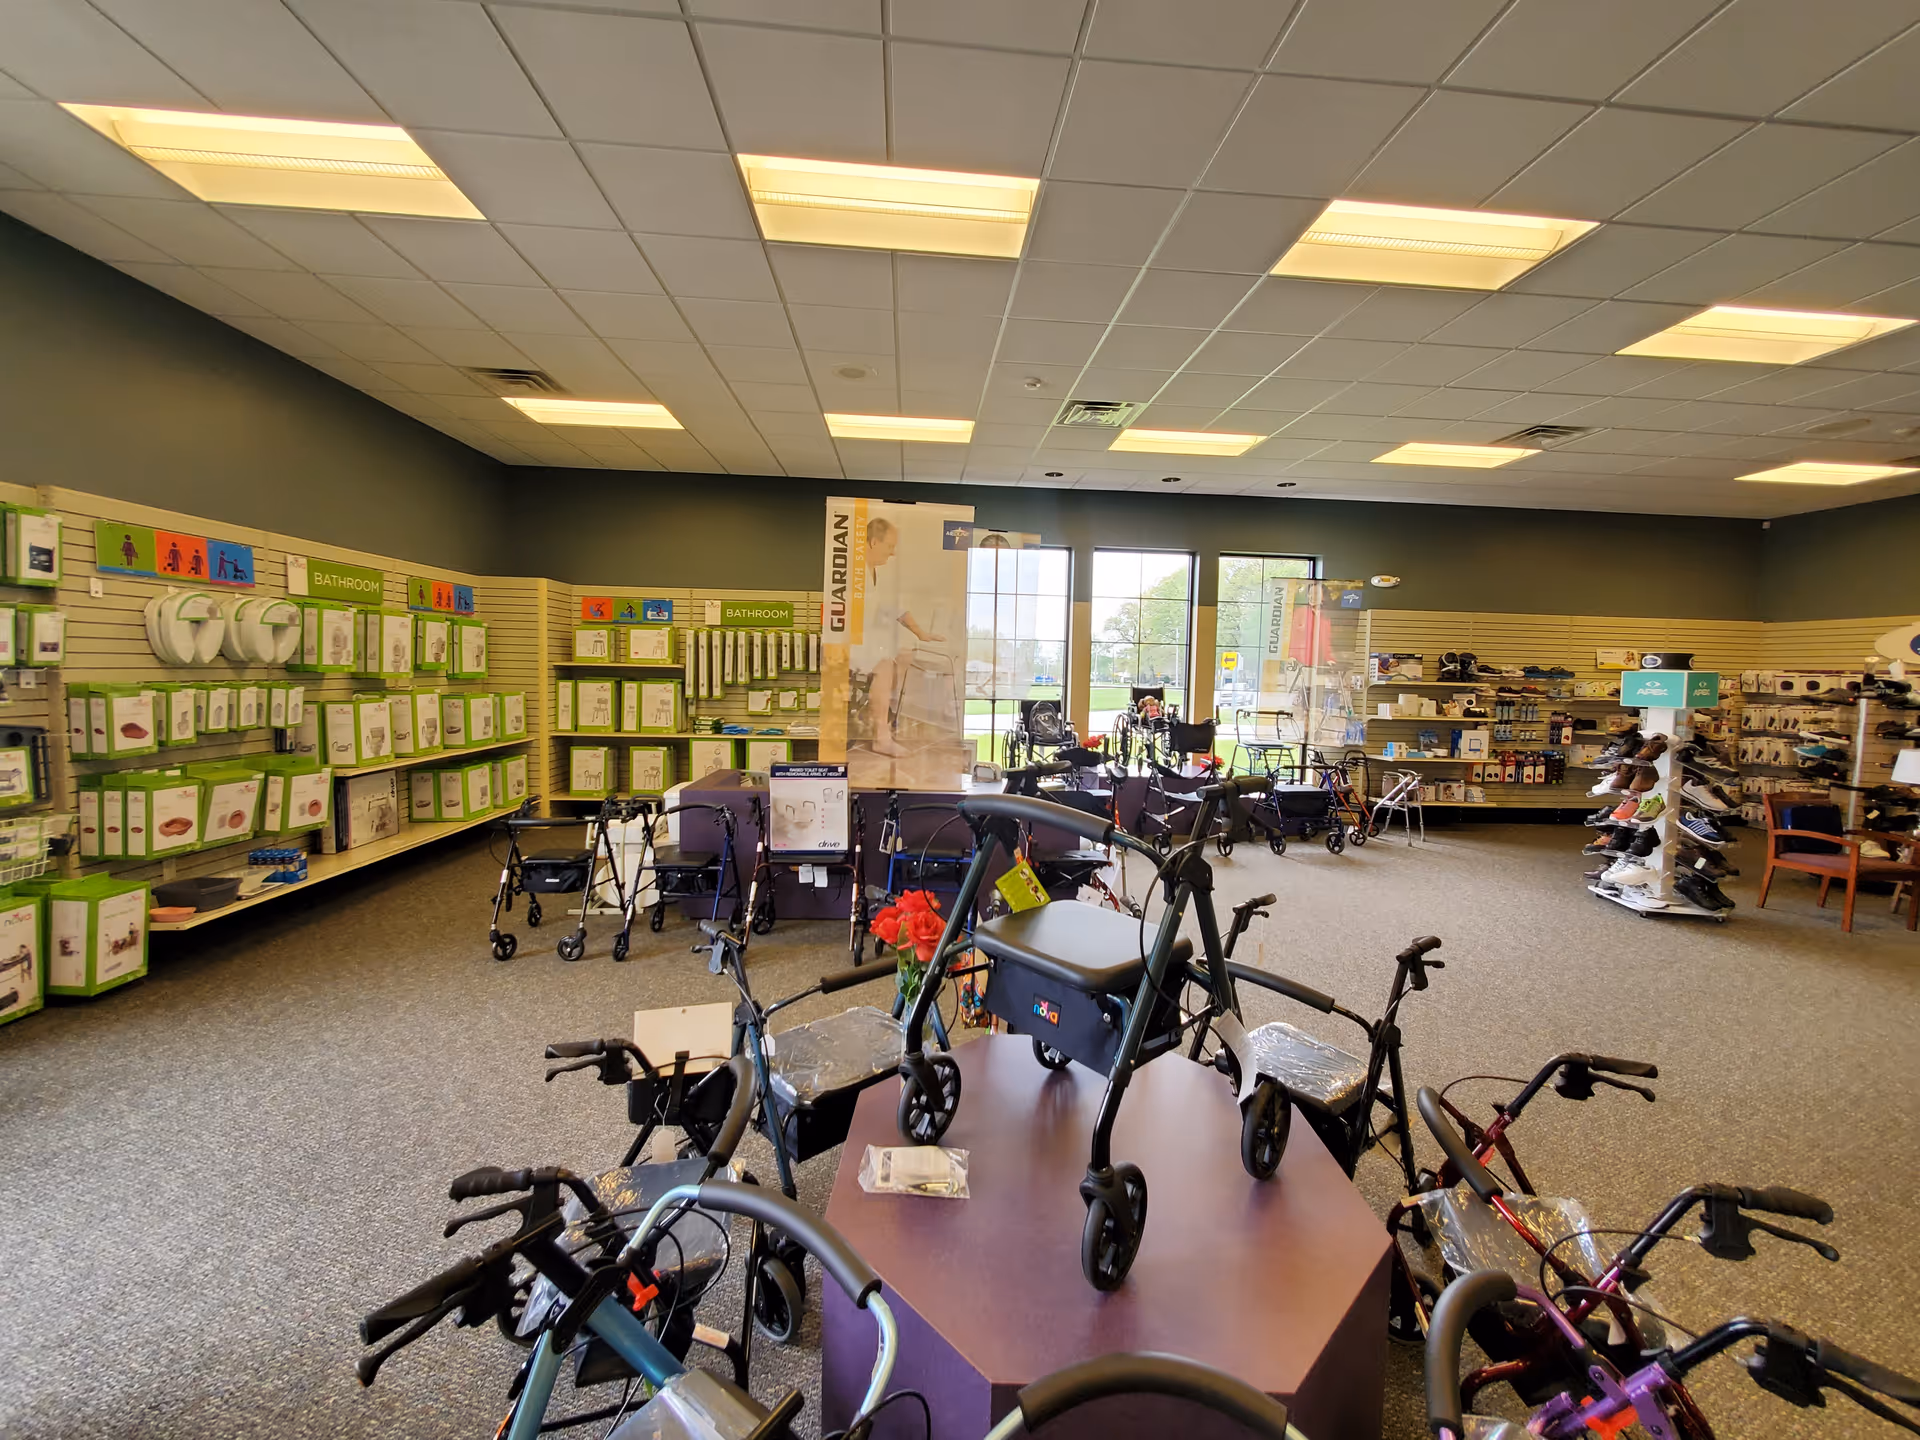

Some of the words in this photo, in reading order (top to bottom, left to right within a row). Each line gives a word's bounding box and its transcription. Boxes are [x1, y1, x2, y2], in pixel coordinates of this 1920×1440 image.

[854, 515, 867, 561] SAFETY
[313, 571, 380, 593] BATHROOM
[830, 513, 850, 633] GUARDIAN
[853, 567, 865, 600] BATH
[726, 608, 789, 619] BATHROOM
[1268, 586, 1285, 654] GUARDIAN
[1636, 688, 1669, 696] APEX
[818, 840, 841, 848] drive
[4, 912, 33, 927] nova
[1033, 1000, 1058, 1025] nova
